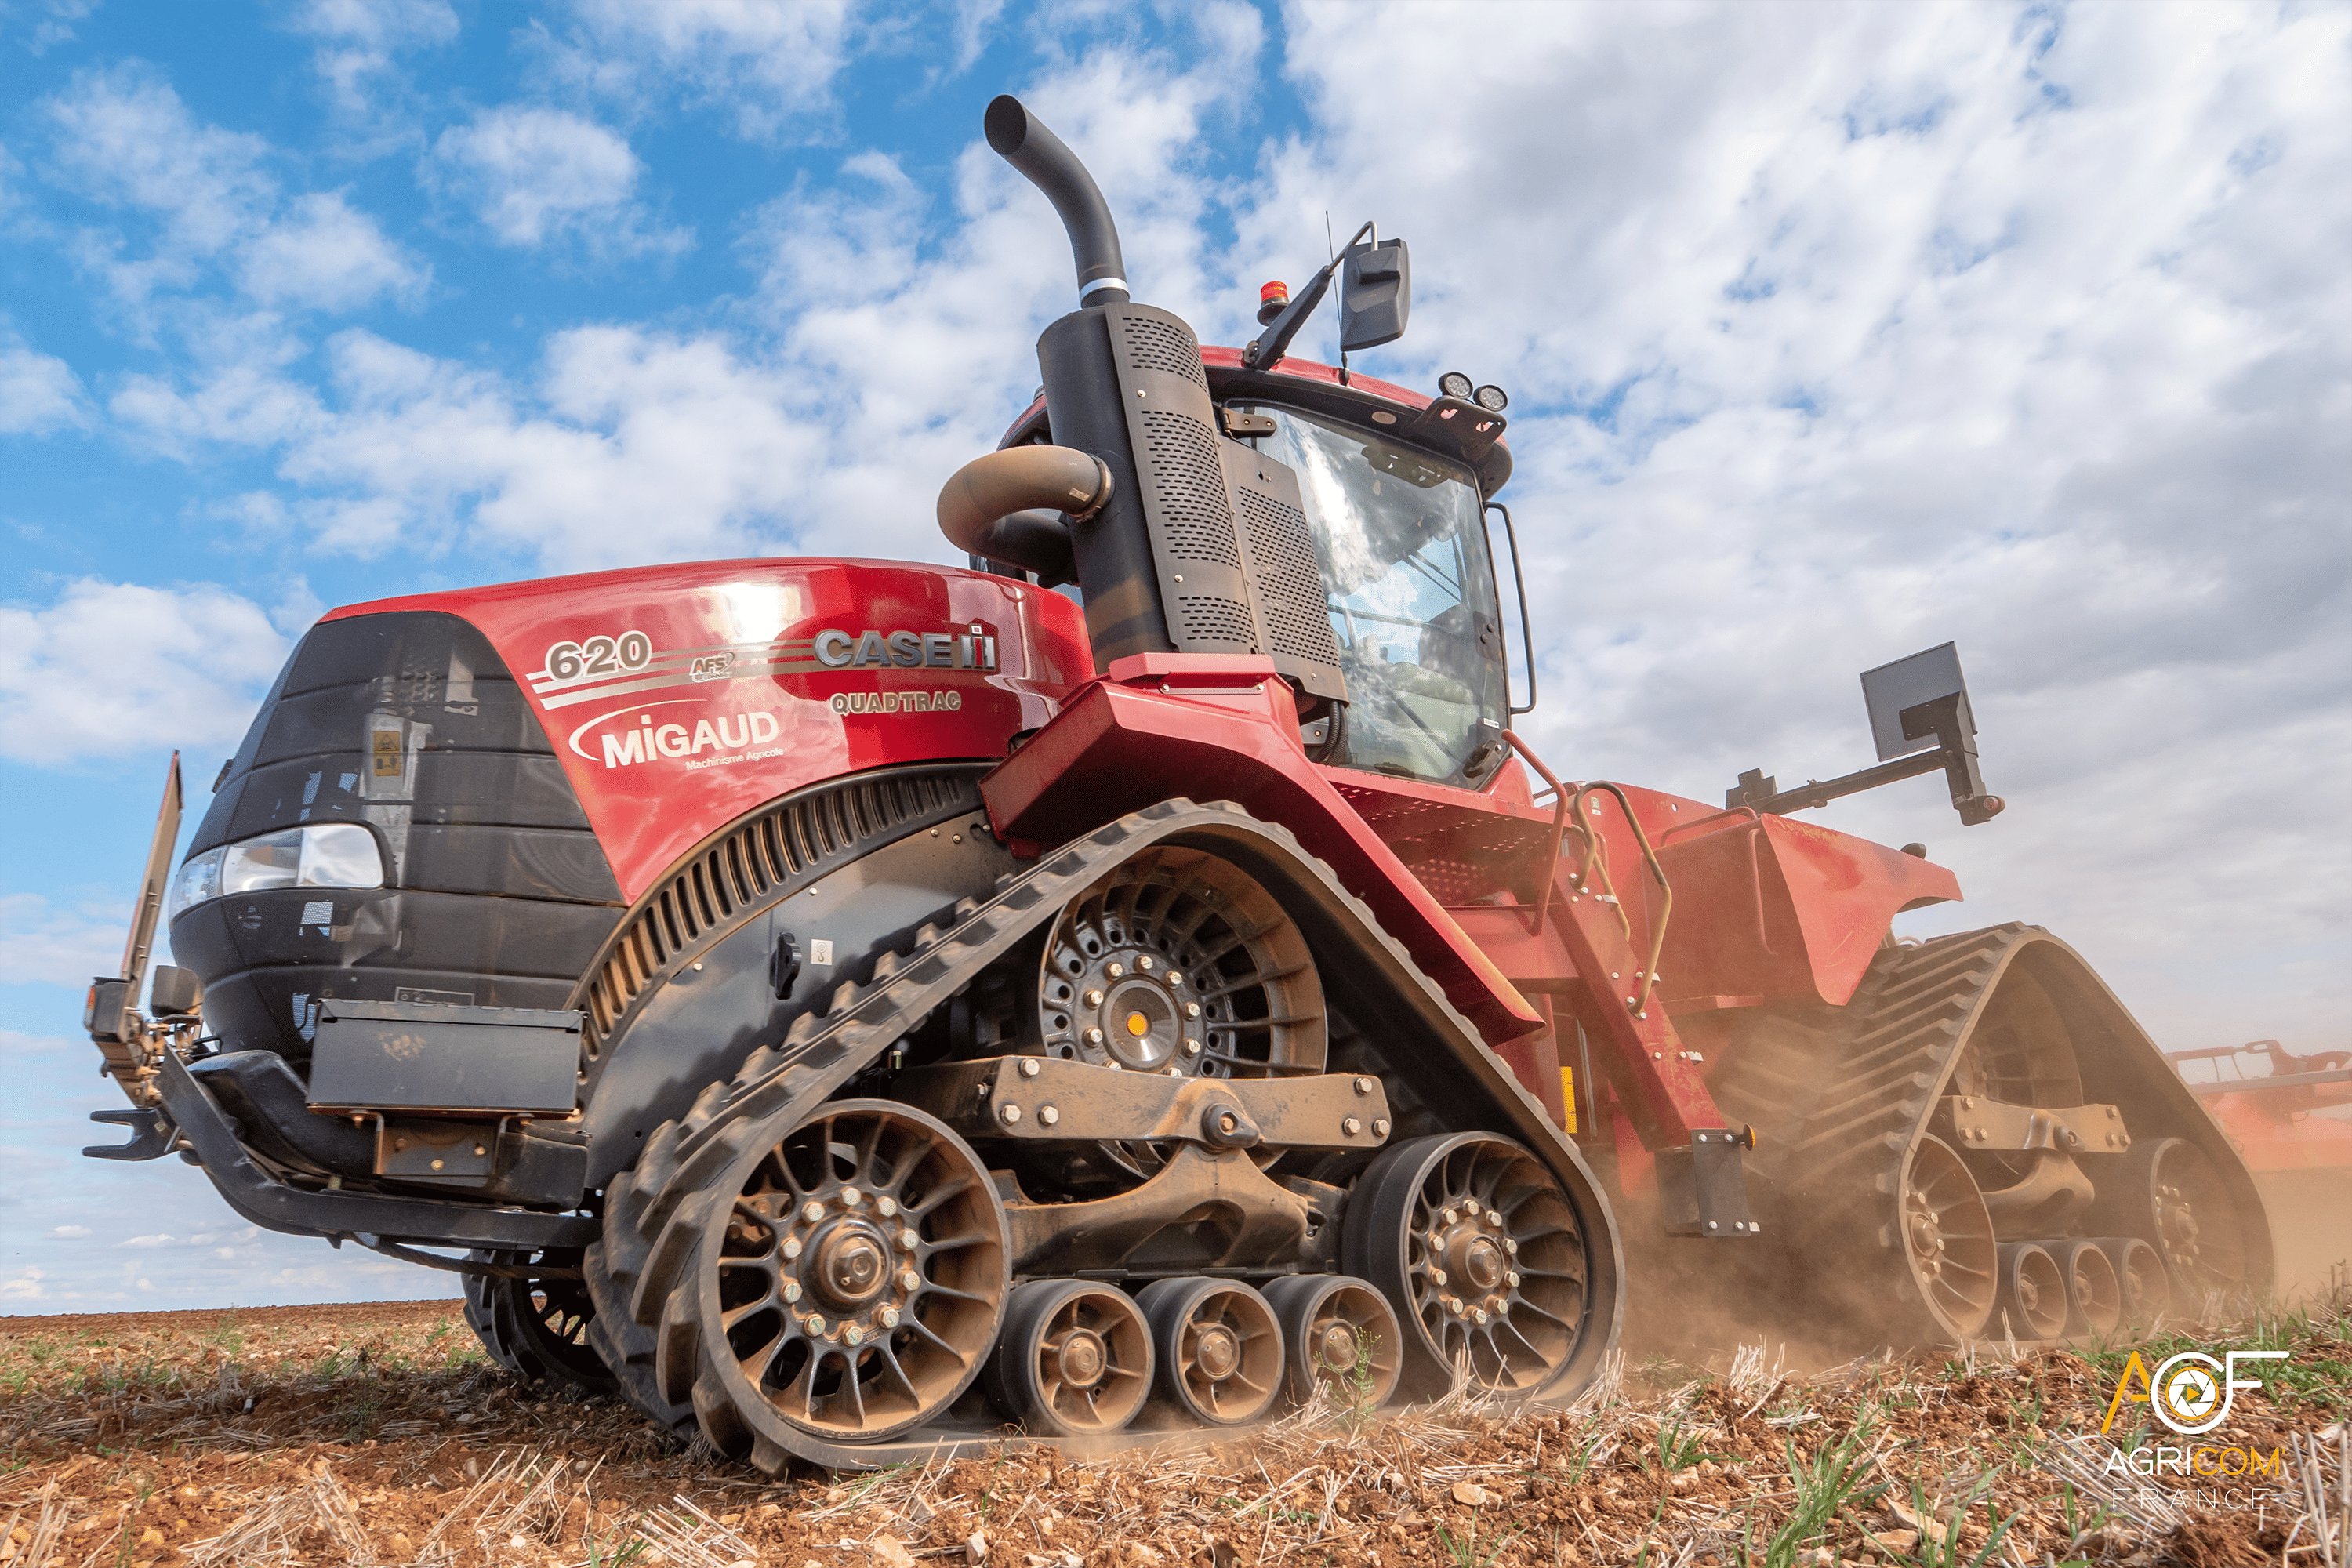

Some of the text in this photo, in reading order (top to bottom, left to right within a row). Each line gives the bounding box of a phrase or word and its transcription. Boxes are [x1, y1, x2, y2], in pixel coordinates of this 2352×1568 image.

[545, 630, 652, 682] 620
[815, 630, 953, 667] CASE
[690, 655, 727, 675] AFS
[829, 691, 962, 716] QUADTRAC
[685, 747, 784, 770] Machinisme Agricole
